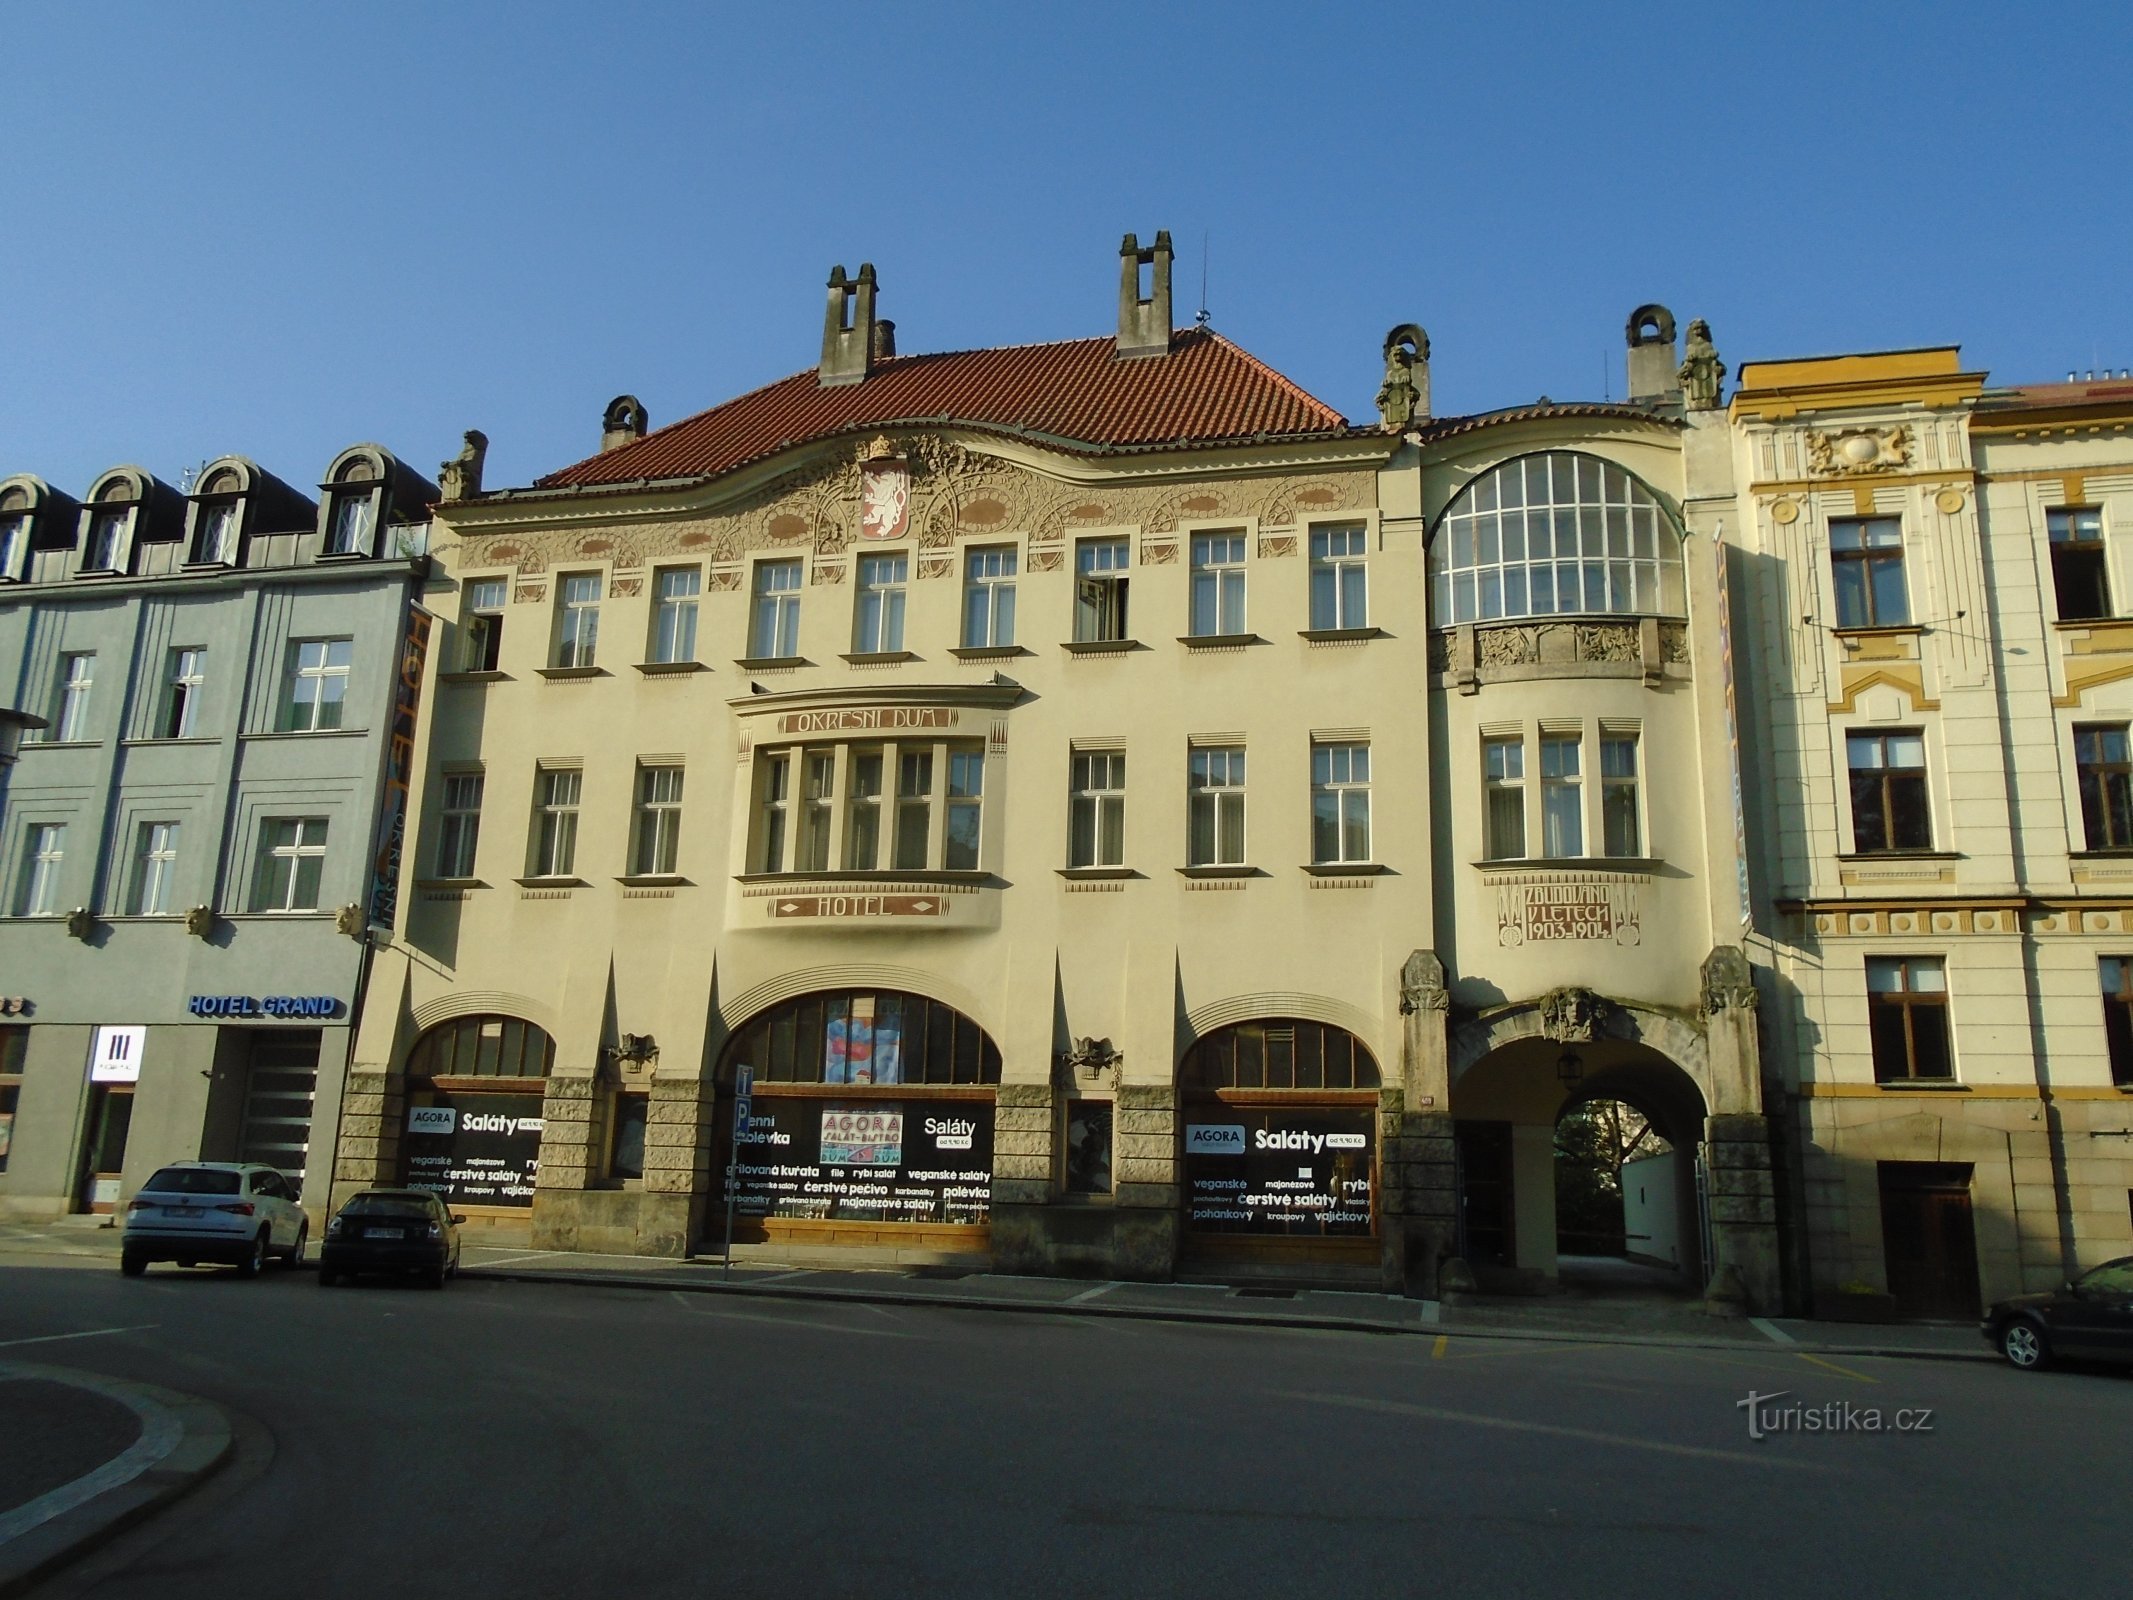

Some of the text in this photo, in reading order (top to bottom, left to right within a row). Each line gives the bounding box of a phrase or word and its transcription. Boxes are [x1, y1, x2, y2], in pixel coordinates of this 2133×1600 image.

[817, 897, 892, 916] HOTEL
[1527, 905, 1609, 922] V LETECH
[188, 995, 336, 1015] HOTEL GRAND
[414, 1112, 451, 1123] AGORA
[737, 1103, 748, 1127] P
[748, 1115, 775, 1127] enní
[823, 1115, 900, 1131] AGORA
[462, 1113, 518, 1136] Saláty
[924, 1117, 976, 1137] Saláty
[746, 1131, 791, 1145] olévka
[1193, 1130, 1241, 1142] AGORA
[1255, 1129, 1325, 1154] Saláty
[526, 1159, 539, 1170] ry
[443, 1167, 486, 1181] čerstvé
[487, 1170, 522, 1184] saláty
[780, 1165, 820, 1178] kuřata
[831, 1168, 845, 1178] filé
[853, 1168, 873, 1179] rybí
[873, 1169, 897, 1179] salát
[908, 1169, 958, 1182] veganské
[958, 1170, 991, 1184] saláty
[804, 1180, 848, 1193] čerstvé
[849, 1183, 889, 1196] pečivo
[942, 1185, 991, 1199] polévka
[1193, 1179, 1248, 1191] veganské
[903, 1199, 936, 1212] saláty
[1237, 1192, 1292, 1206] čerstvé
[1294, 1193, 1338, 1209] saláty
[1193, 1208, 1371, 1224] pohankový kroupový vajíčkový
